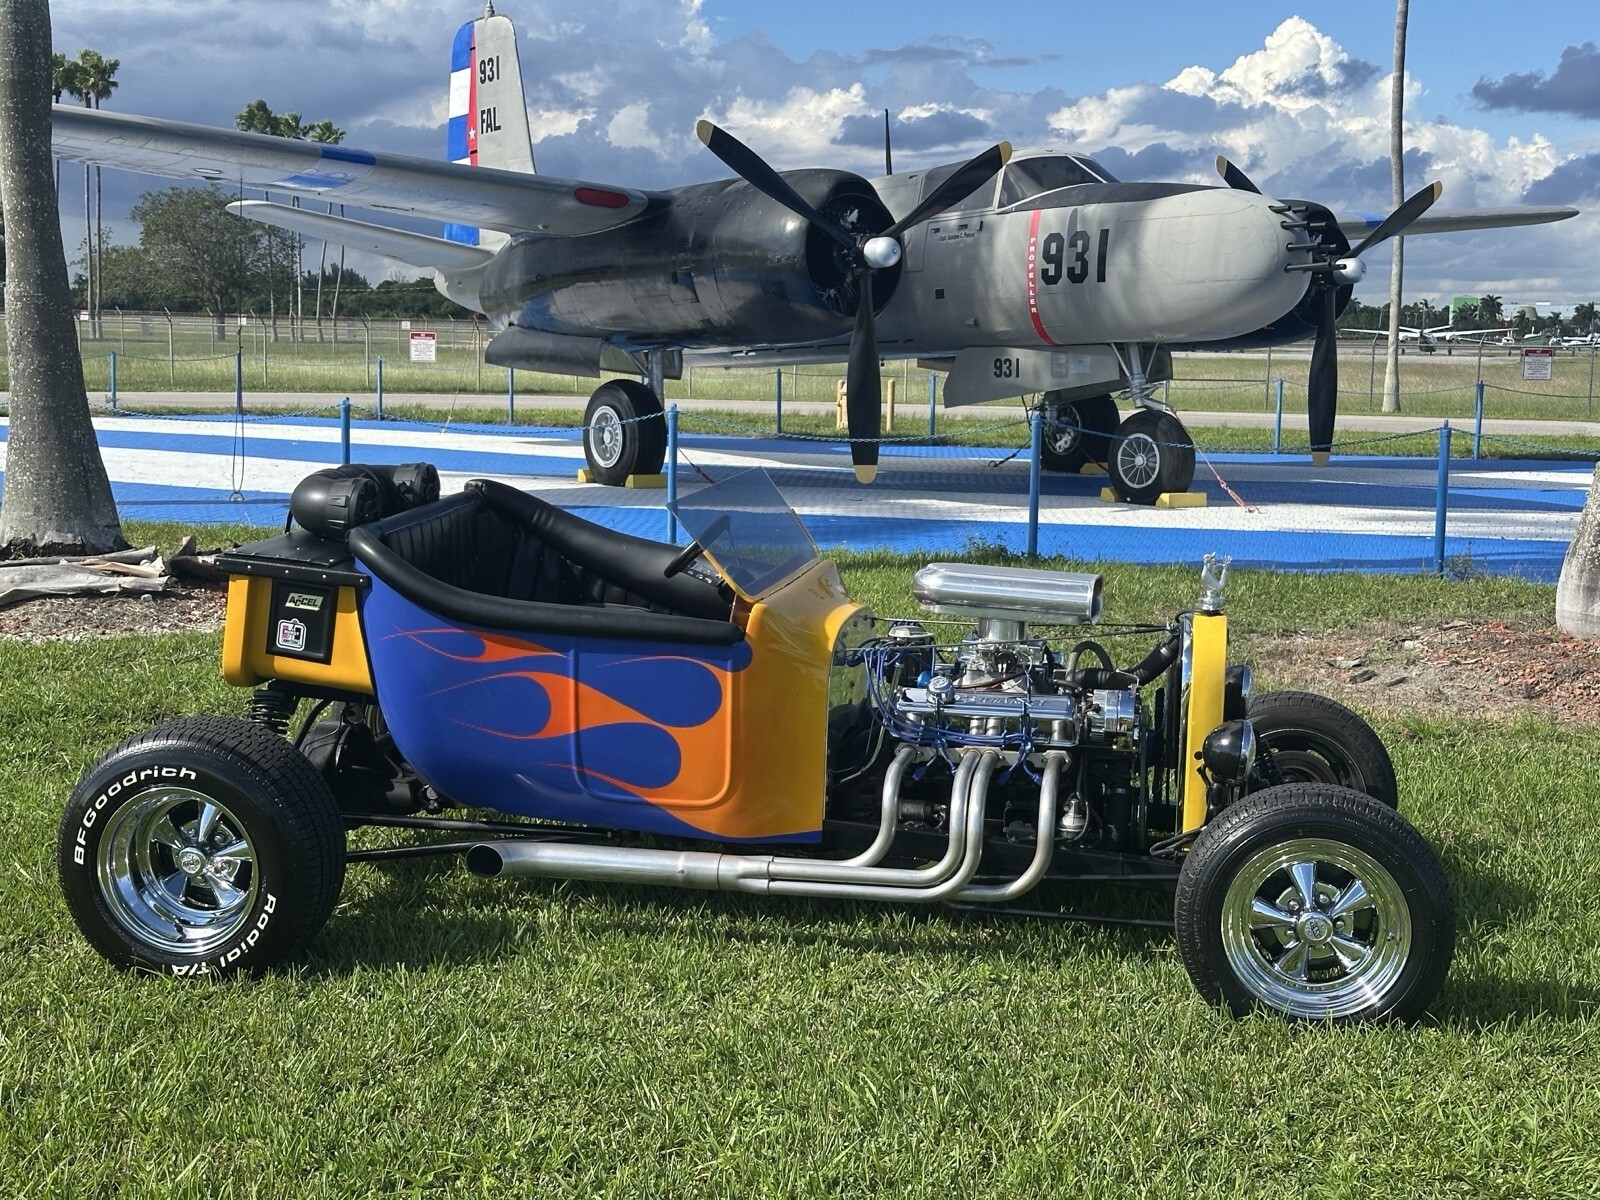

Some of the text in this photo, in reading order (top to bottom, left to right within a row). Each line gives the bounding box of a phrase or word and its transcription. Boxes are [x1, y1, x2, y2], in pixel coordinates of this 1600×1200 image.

[480, 55, 499, 84] 931
[480, 107, 501, 134] FAL
[1028, 237, 1037, 313] PROPELLER
[1041, 229, 1109, 285] 931
[993, 358, 1019, 378] 931
[289, 595, 318, 606] ACCEL
[74, 766, 196, 865] BFGoodrich
[171, 893, 276, 976] Radial T/A
